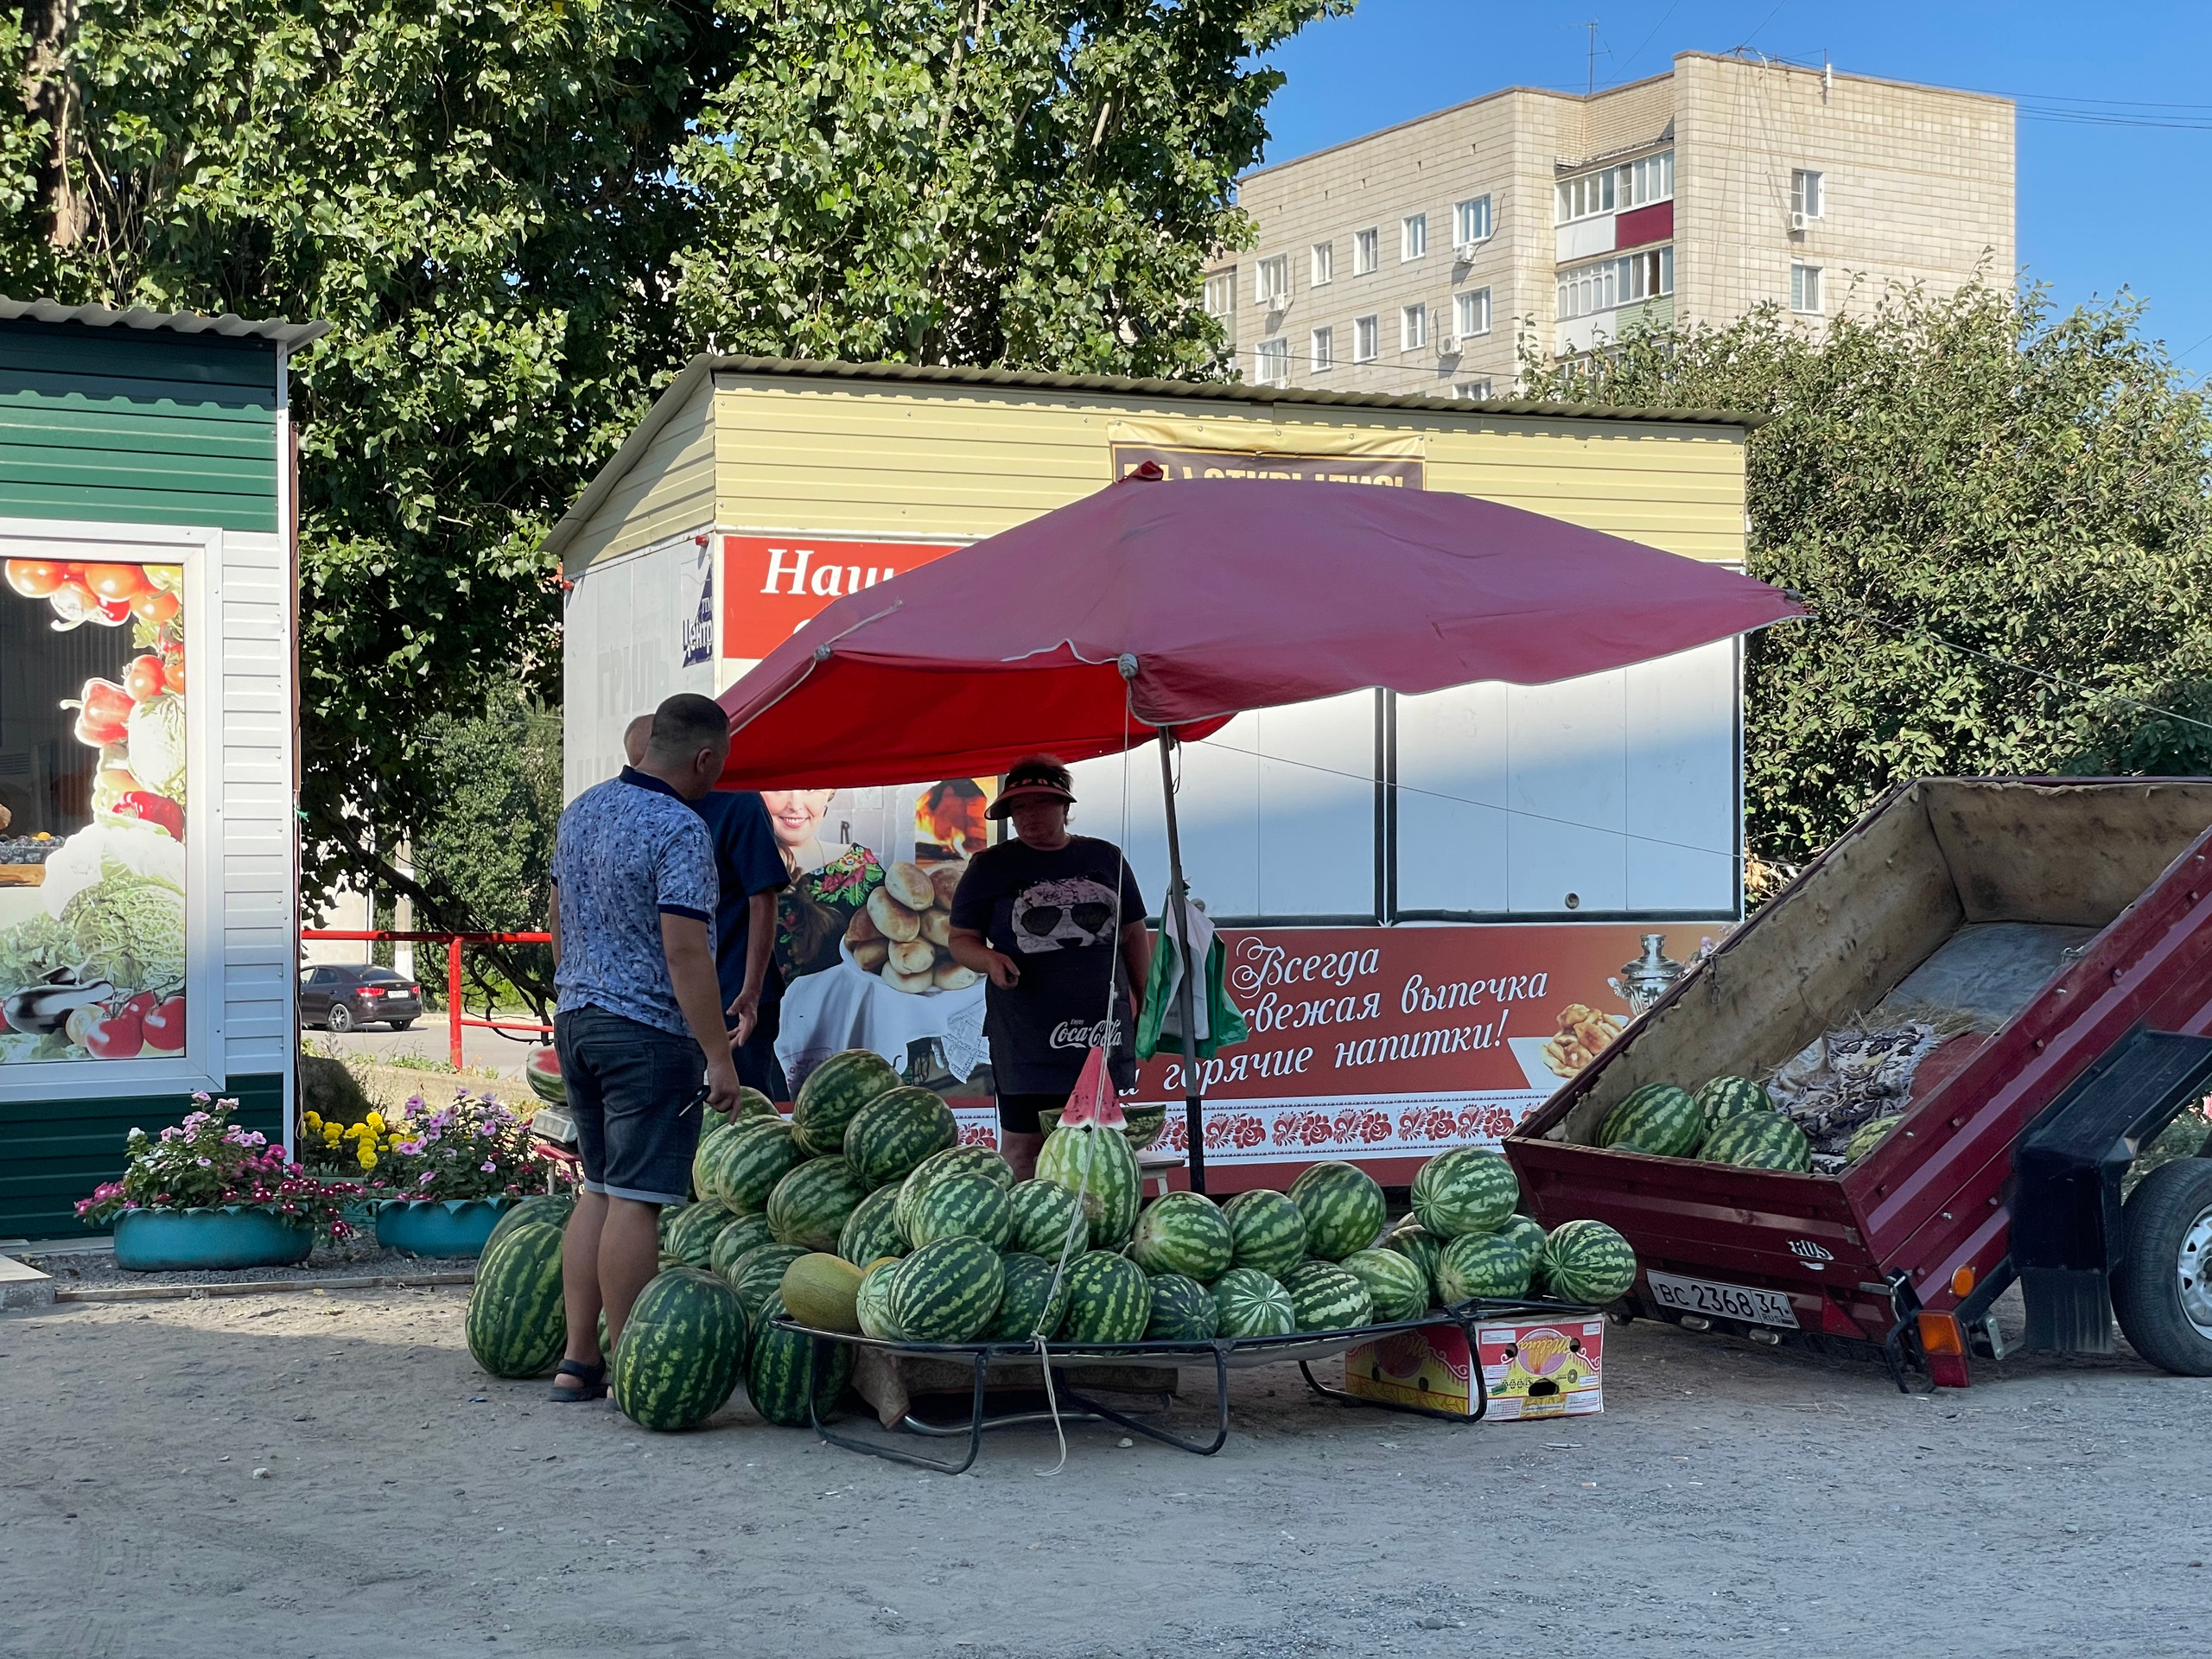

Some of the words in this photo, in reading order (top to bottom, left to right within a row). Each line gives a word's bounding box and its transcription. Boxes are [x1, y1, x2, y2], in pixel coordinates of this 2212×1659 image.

[760, 548, 895, 596] Наш
[1232, 937, 1379, 998] Всегда
[1401, 972, 1548, 1014] выпечка
[1335, 1009, 1510, 1070] напитки!
[1755, 1294, 1784, 1316] 34
[1762, 1313, 1782, 1324] RUS
